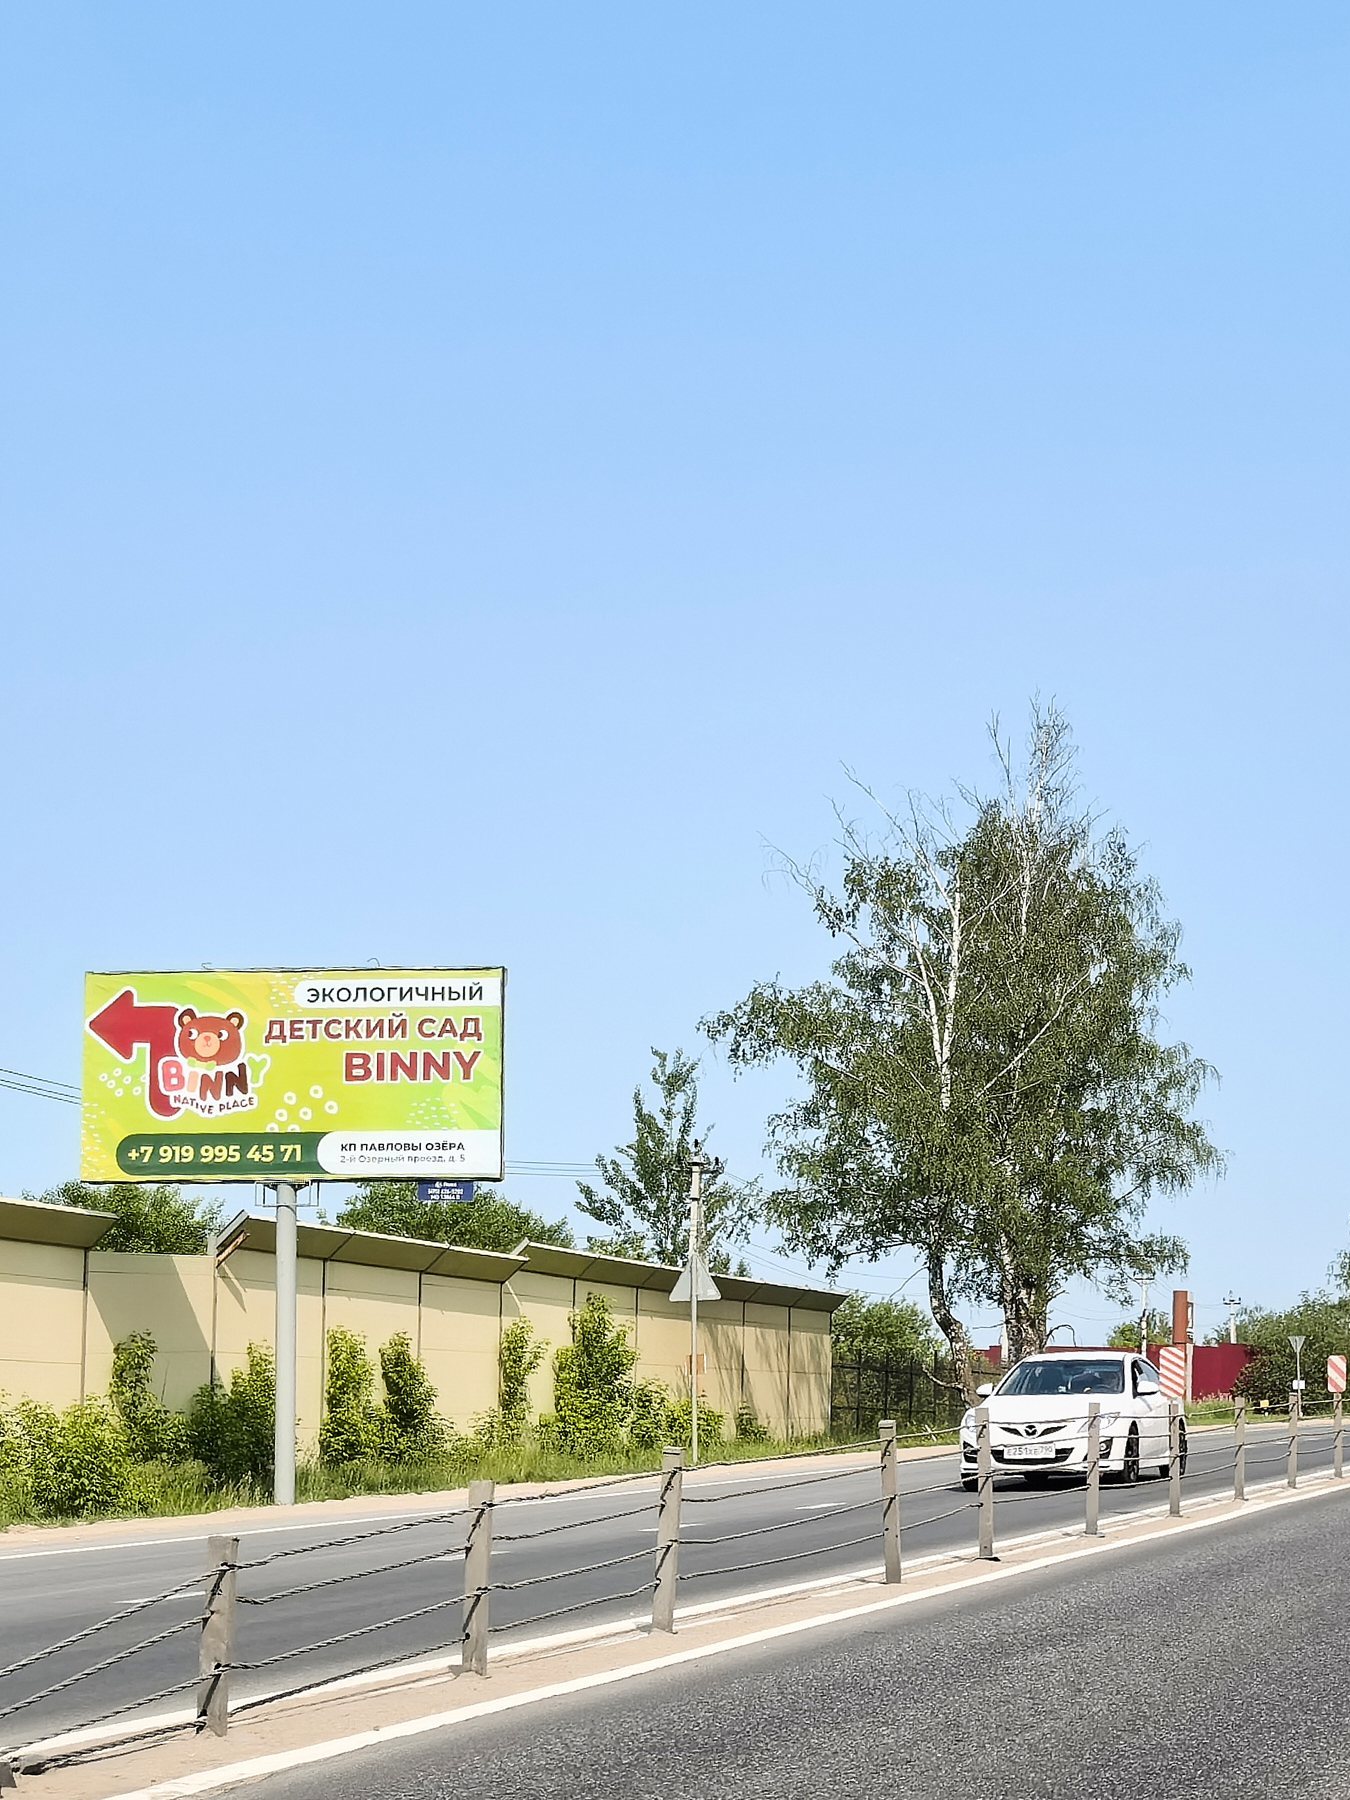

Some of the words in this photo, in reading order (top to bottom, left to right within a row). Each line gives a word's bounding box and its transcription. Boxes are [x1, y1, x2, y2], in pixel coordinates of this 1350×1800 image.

[307, 982, 483, 1003] ЭКОЛОГИЧНЫЙ
[265, 1013, 407, 1043] ДЕТСКИЙ
[417, 1017, 482, 1041] САД
[345, 1051, 481, 1081] BINNY
[162, 1056, 267, 1101] BINNY
[174, 1094, 214, 1114] NATIVE
[219, 1097, 254, 1112] PLACE
[127, 1145, 153, 1163] +7
[159, 1145, 195, 1163] 919
[200, 1145, 241, 1163] 995
[246, 1144, 274, 1163] 45
[280, 1144, 302, 1162] 71
[340, 1143, 356, 1152] КП
[360, 1142, 421, 1152] ПАВЛОВЫ
[425, 1140, 465, 1151] ОЗЁРА
